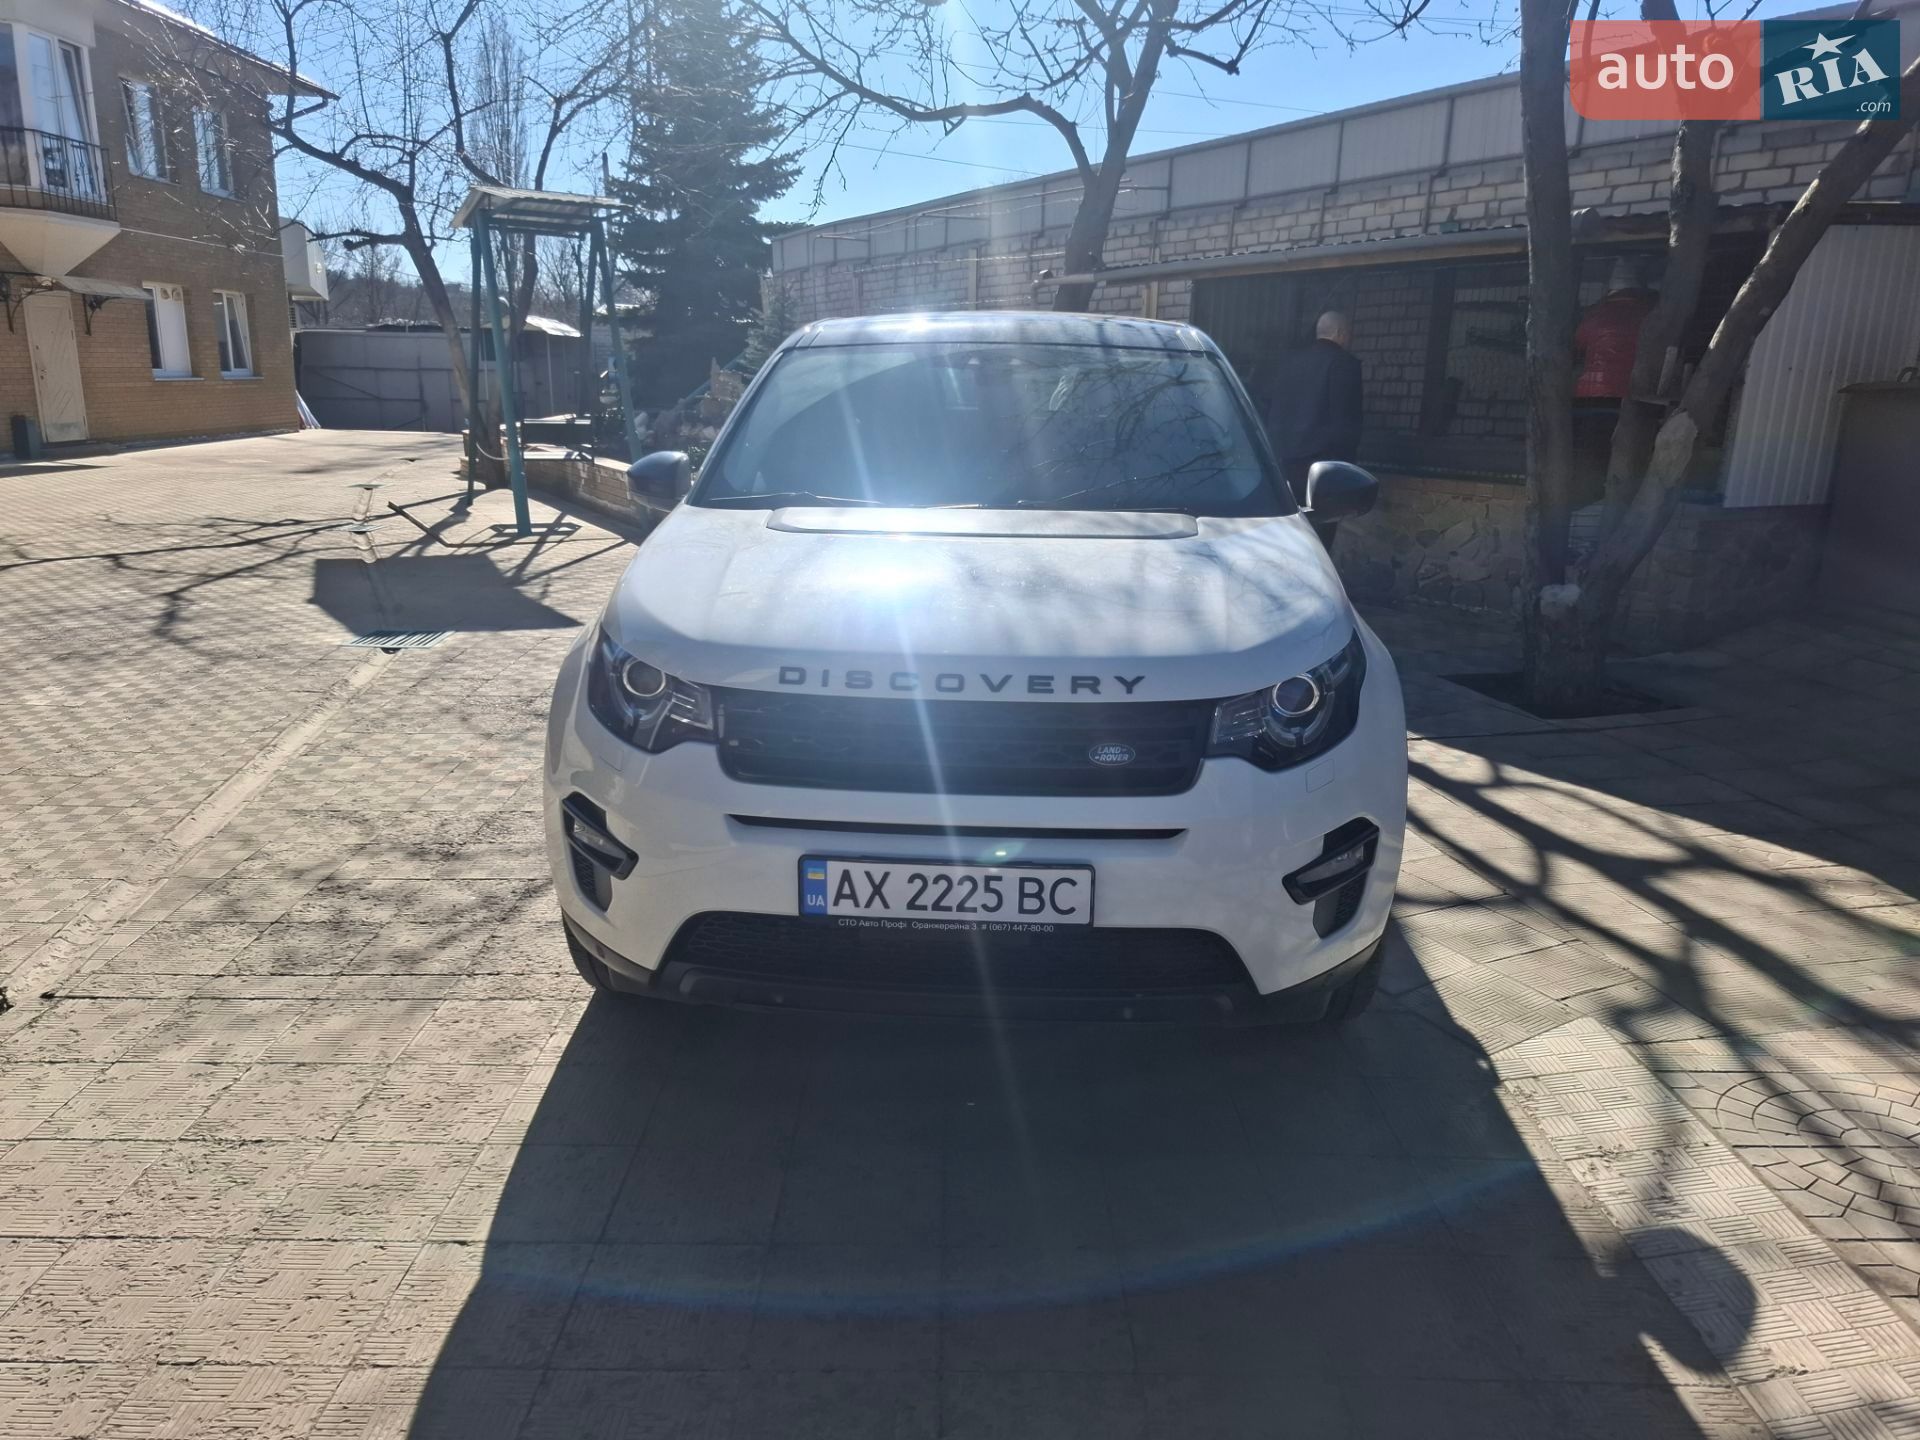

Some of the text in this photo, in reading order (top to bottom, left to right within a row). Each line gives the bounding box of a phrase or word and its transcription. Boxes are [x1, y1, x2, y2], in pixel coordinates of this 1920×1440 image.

[779, 666, 1145, 695] DISCOVERY
[807, 894, 824, 907] UA
[832, 869, 1077, 916] AX 2225 BC
[838, 918, 857, 927] СТО
[859, 919, 879, 928] Авто
[989, 923, 1011, 931] (067)
